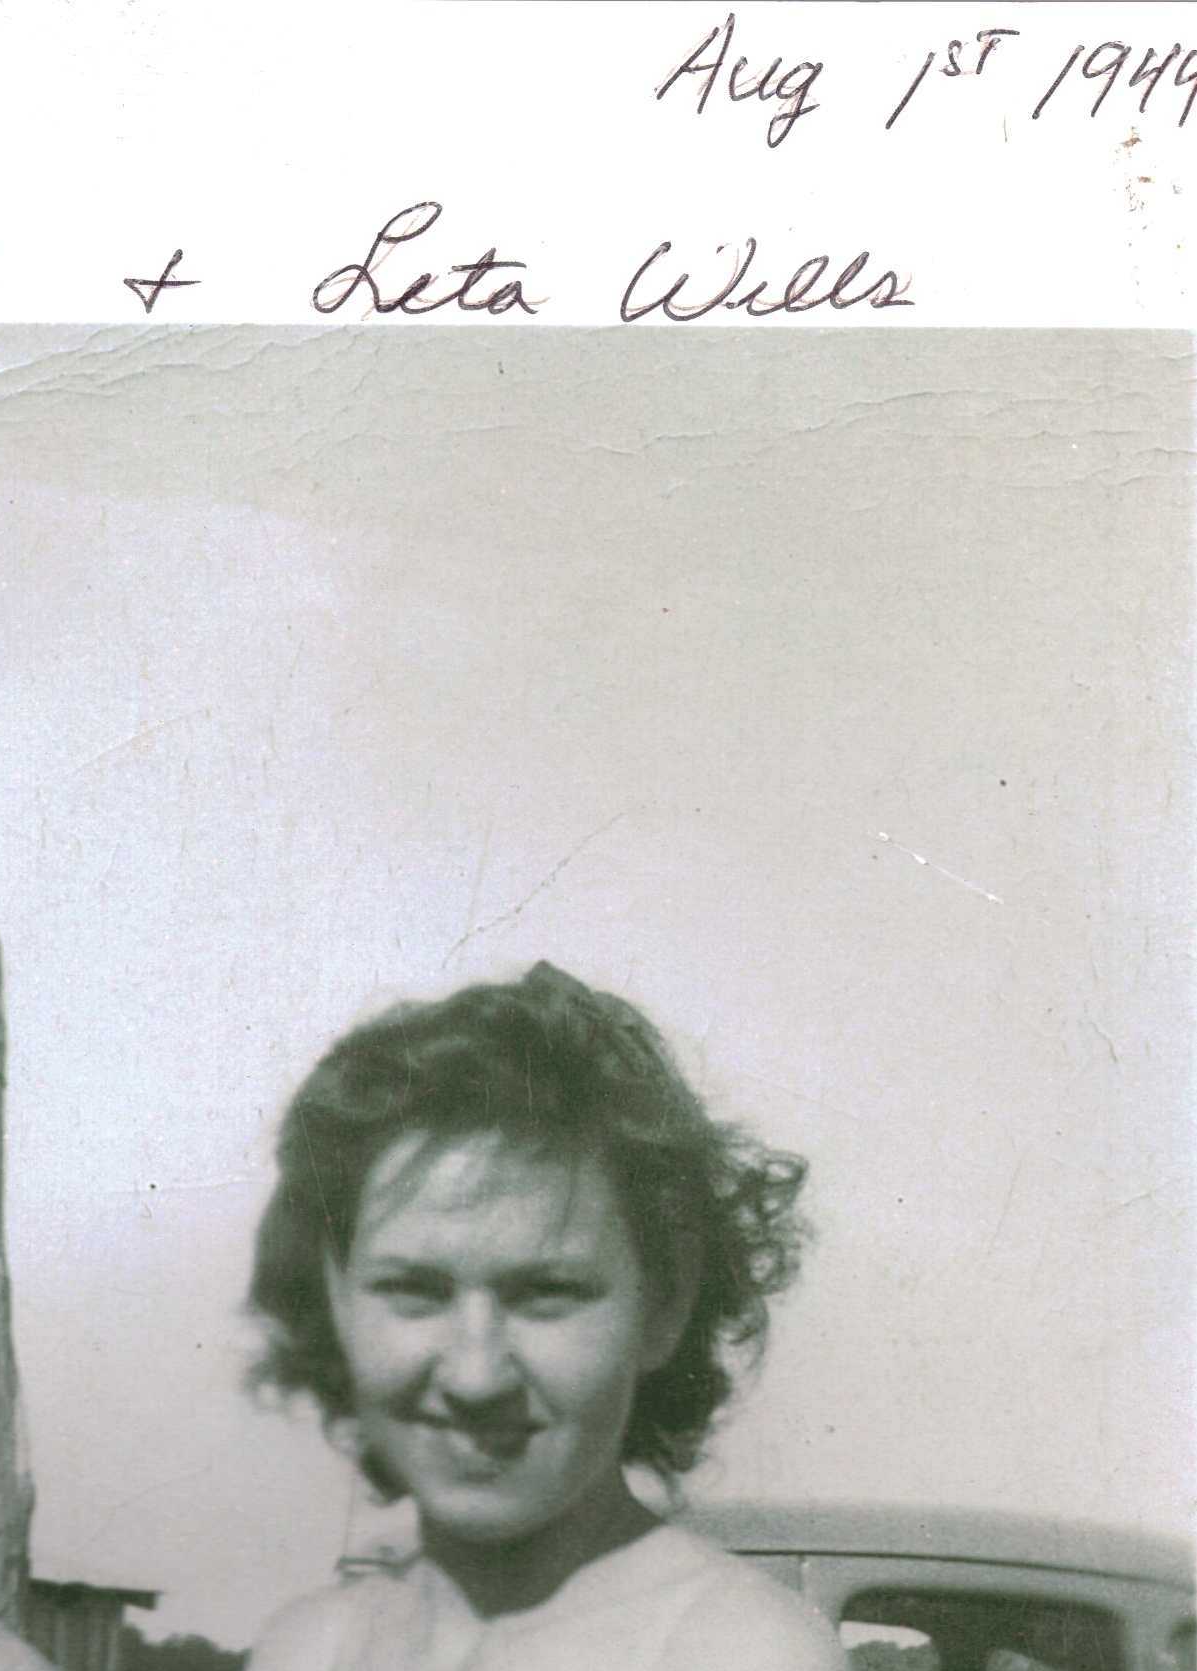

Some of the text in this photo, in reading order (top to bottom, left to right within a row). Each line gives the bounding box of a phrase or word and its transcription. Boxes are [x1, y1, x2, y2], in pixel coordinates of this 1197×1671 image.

[655, 13, 825, 149] Aug
[312, 203, 539, 315] Leta
[620, 239, 915, 323] Wills
